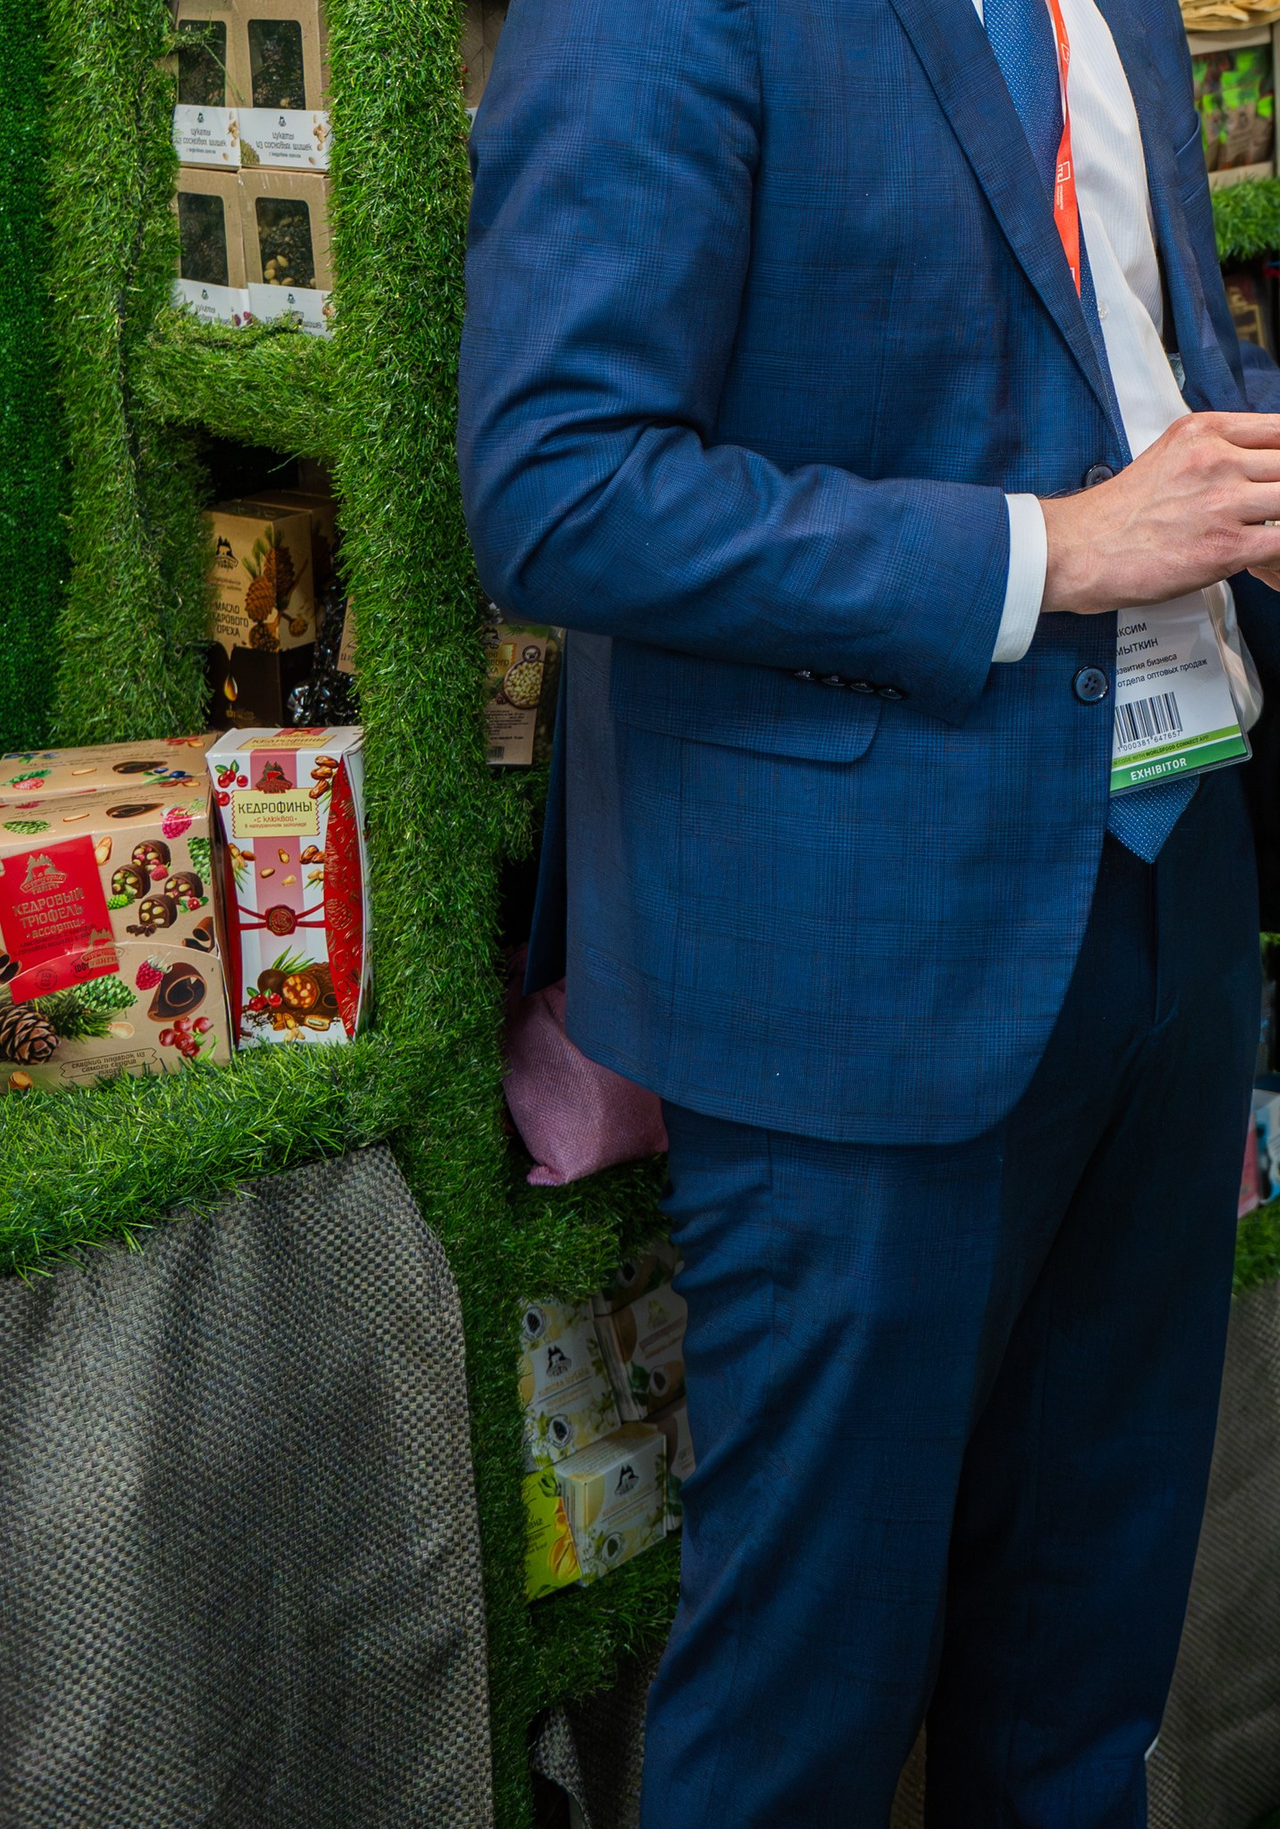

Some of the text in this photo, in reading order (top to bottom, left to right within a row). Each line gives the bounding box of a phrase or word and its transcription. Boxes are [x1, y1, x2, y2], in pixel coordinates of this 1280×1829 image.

[209, 138, 227, 147] шишек
[264, 140, 291, 150] сосновых
[292, 142, 314, 151] шишек
[215, 601, 240, 615] МАСЛО
[1117, 622, 1148, 639] КСИМ
[1116, 637, 1159, 657] МЫТКИН
[1146, 652, 1178, 668] бизнеса
[1117, 657, 1208, 689] отдела оптовых продаж
[1145, 743, 1176, 758] WORLDFOOD
[1176, 737, 1199, 749] CONNECT
[1199, 734, 1209, 742] APP
[1130, 757, 1188, 782] EXHIBITOR
[238, 801, 313, 815] КЕДРОФИНЫ
[263, 815, 295, 823] клюквой
[12, 887, 86, 917] КЕДРОВЫЙ
[20, 906, 84, 929] ТРЮФЕЛЬ
[71, 1051, 145, 1070] сладкий подарок из
[81, 1058, 137, 1074] самого сердца
